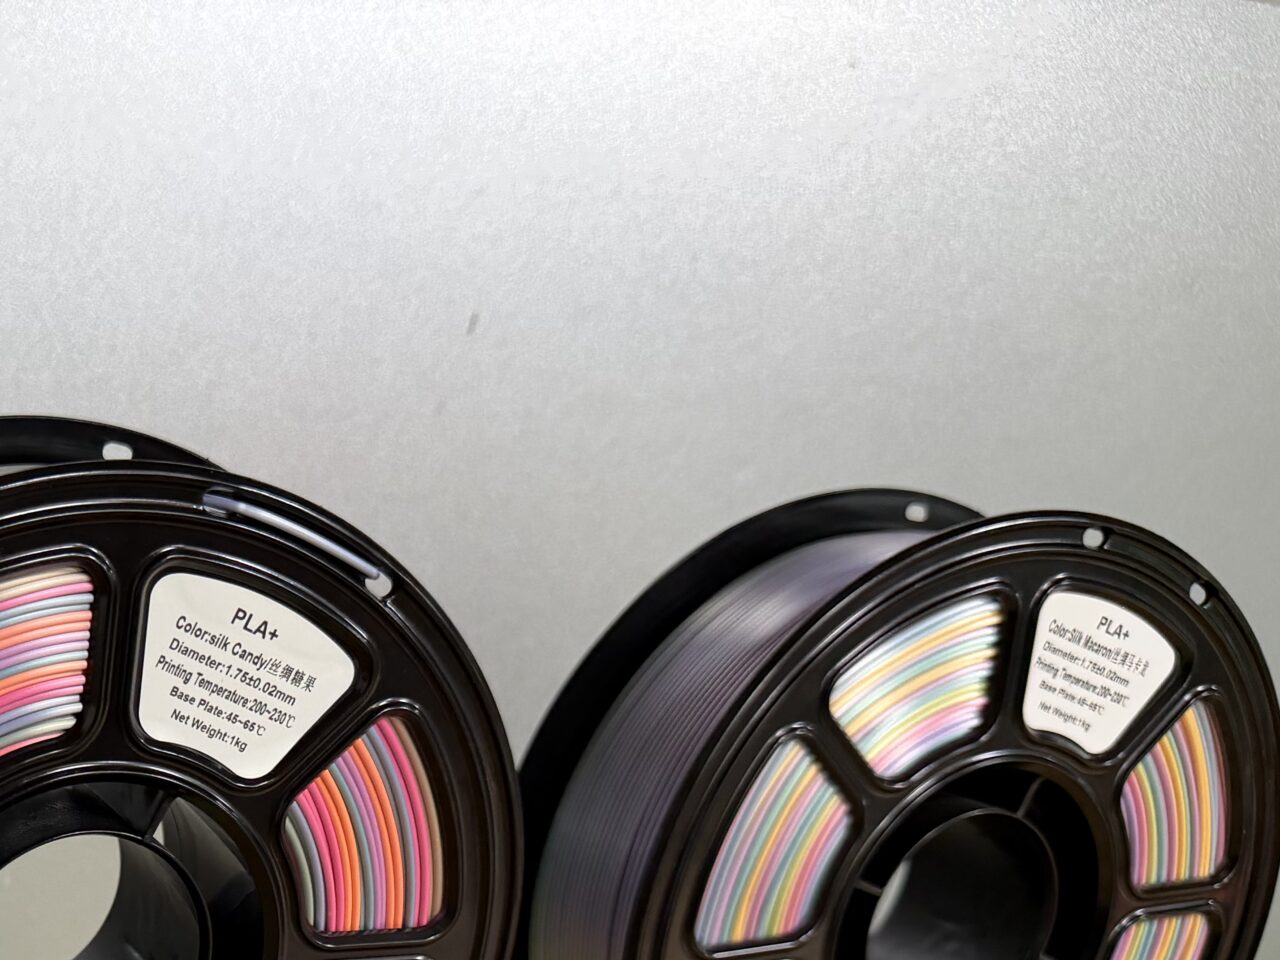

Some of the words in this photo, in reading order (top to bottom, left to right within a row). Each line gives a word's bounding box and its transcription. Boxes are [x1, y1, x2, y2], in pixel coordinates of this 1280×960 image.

[175, 615, 230, 652] Color:silk
[230, 607, 279, 641] PLA+
[1096, 615, 1130, 640] PLA+
[155, 655, 193, 685] Printing
[168, 638, 296, 706] Diameter:1.75±0.02mm
[169, 686, 196, 705] Base
[170, 708, 190, 725] Net
[191, 718, 248, 753] Weight:1kg
